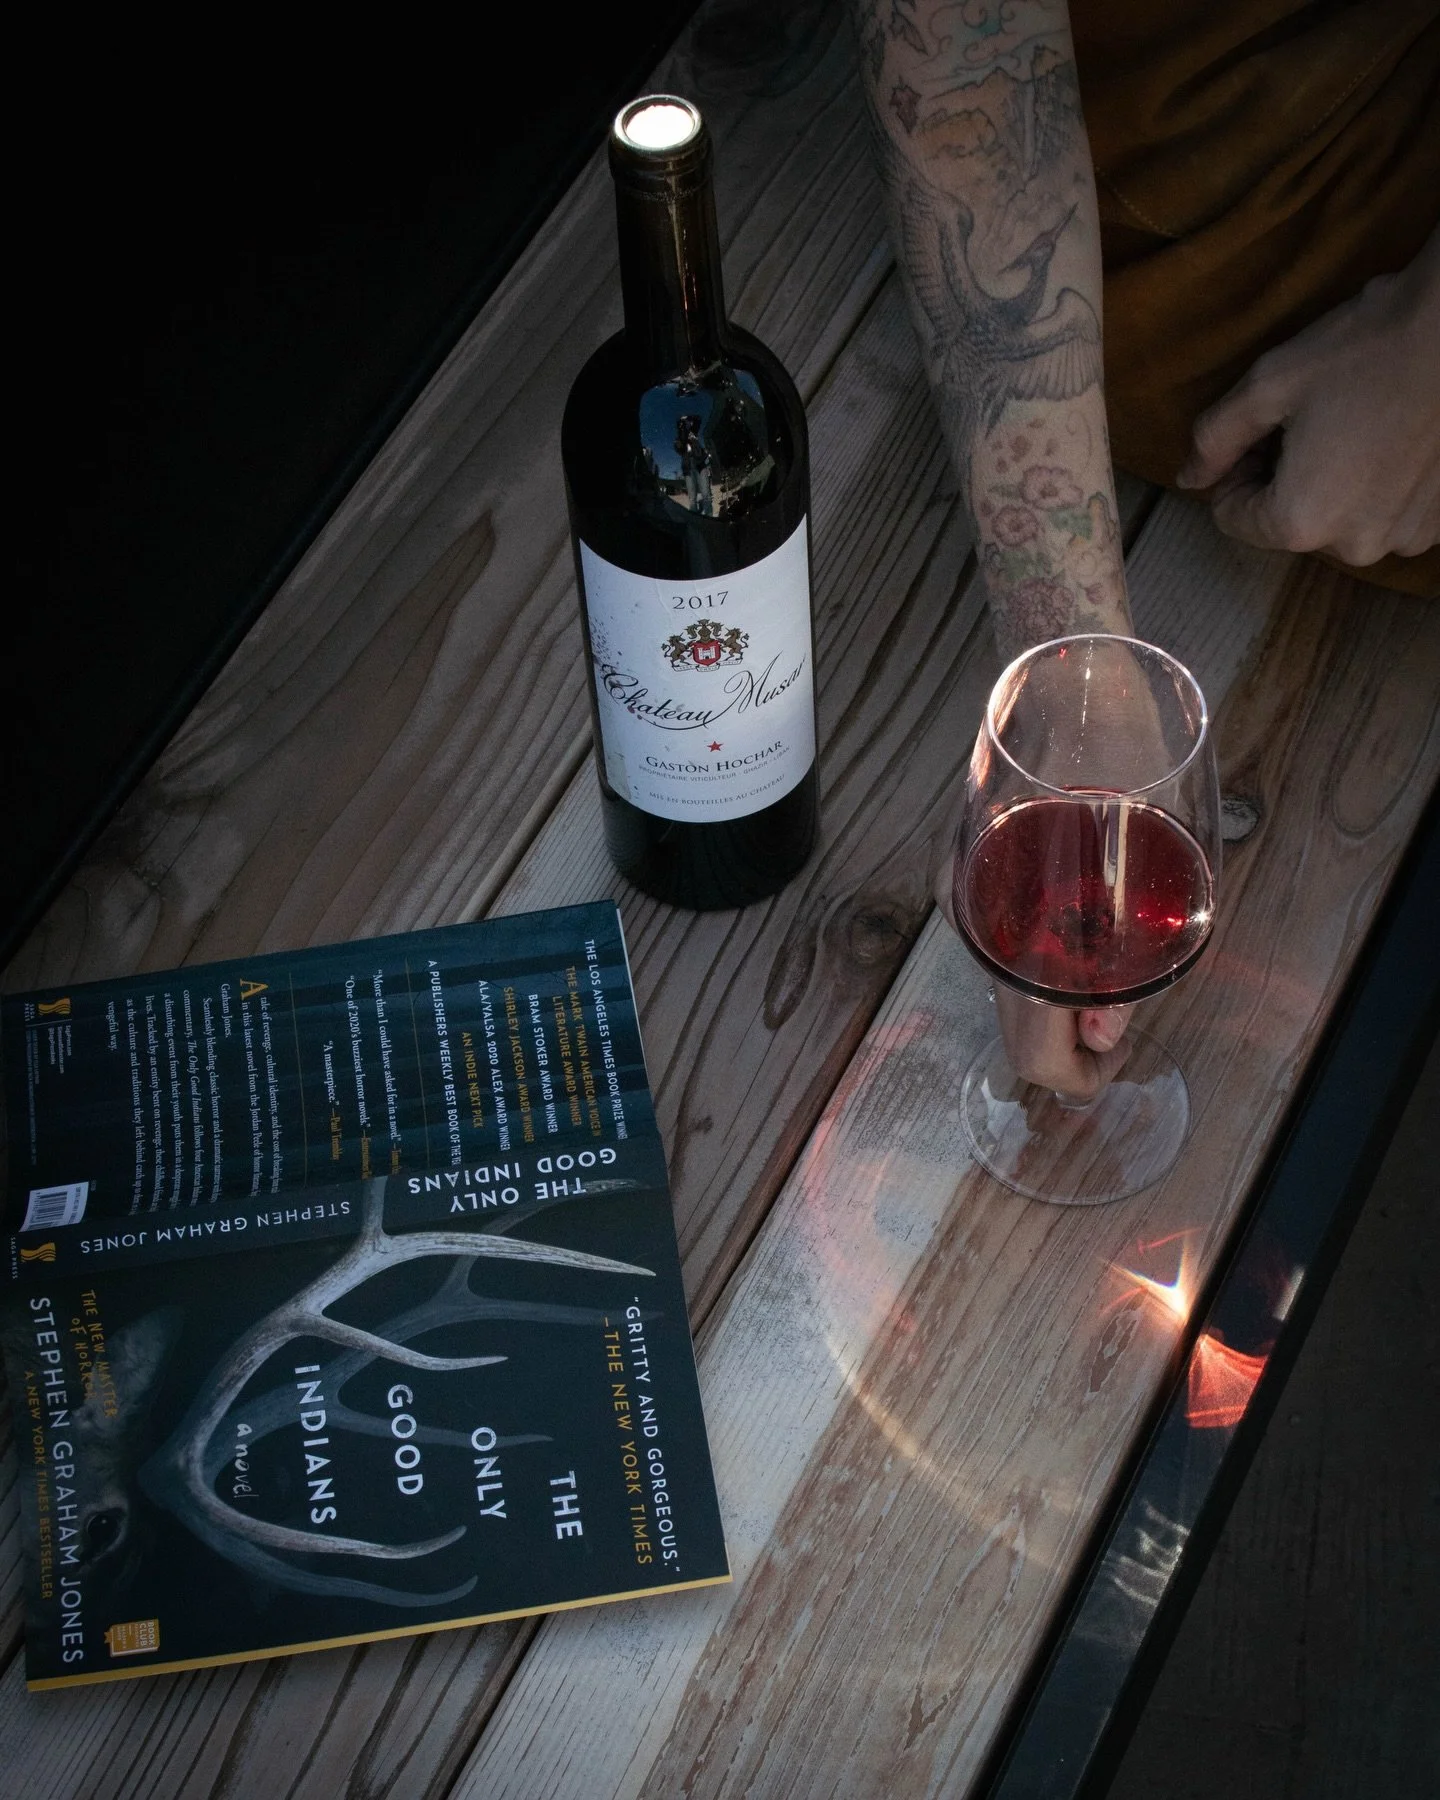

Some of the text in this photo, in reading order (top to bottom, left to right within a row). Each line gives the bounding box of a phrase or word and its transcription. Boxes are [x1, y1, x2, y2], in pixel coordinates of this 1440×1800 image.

[672, 591, 729, 610] 2017
[646, 740, 783, 774] GASTON HOCHAR
[584, 939, 596, 960] THE
[345, 975, 354, 998] “One
[372, 969, 383, 996] “More
[588, 964, 600, 985] LOS
[105, 1001, 118, 1050] vengeful way.
[220, 983, 232, 1037] Graham Jones.
[347, 1000, 358, 1009] of
[348, 1011, 360, 1038] 2020’s
[375, 998, 386, 1017] than
[429, 971, 447, 1035] PUBLISHERS
[592, 989, 609, 1036] ANGELES
[239, 978, 282, 1139] A tale cultural and the
[323, 1040, 332, 1051] “A
[351, 1039, 362, 1072] buzziest
[379, 1025, 391, 1048] could
[382, 1050, 391, 1068] have
[439, 1039, 453, 1080] WEEKLY
[502, 986, 531, 1113] SHIRLEY JACKSON AWARD
[565, 966, 600, 1129] THE MARK TWAIN AMERICAN VOICE
[601, 1039, 614, 1069] TIMES
[145, 995, 165, 1164] lives. Tracked by entity bent these
[164, 998, 184, 1156] disturbing event from their youth puts them
[202, 997, 223, 1133] Seamlessly blending classic horror and
[242, 1012, 261, 1131] this latest novel from the Jordan
[323, 1053, 339, 1105] masterpiece.”
[384, 1070, 396, 1092] asked
[461, 1032, 483, 1128] AN INDIE NEXT PICK
[478, 980, 510, 1150] ALA/YALSA 2020 ALEX AWARD WINNER
[528, 994, 557, 1133] BRAM STOKER AWARD WINNER
[552, 995, 581, 1126] LITERATURE AWARD WINNER
[127, 1008, 145, 1163] the culture and traditions they left behind
[186, 1055, 203, 1148] Only Good follows
[355, 1073, 365, 1099] horror
[386, 1093, 397, 1105] for
[444, 1084, 456, 1105] BEST
[606, 1071, 620, 1097] BOOK
[447, 1108, 459, 1132] BOOK
[611, 1098, 623, 1120] PRIZE
[449, 1133, 460, 1143] OF
[451, 1144, 461, 1156] THE
[407, 1148, 616, 1193] GOOD INDIANS
[450, 1177, 586, 1212] THE ONLY
[80, 1201, 349, 1253] STEPHEN GRAHAM JONES
[70, 1318, 97, 1401] OF HORROR
[81, 1290, 118, 1417] THE NEW MASTER
[611, 1384, 632, 1430] NEW
[638, 1395, 657, 1437] AND
[232, 1424, 259, 1498] a novel
[294, 1365, 336, 1523] INDIANS
[387, 1384, 422, 1494] GOOD
[24, 1371, 53, 1599] A NEW YORK TIMES BESTSELLER
[30, 1297, 83, 1662] STEPHEN GRAHAM JONES
[471, 1427, 506, 1518] ONLY
[620, 1441, 641, 1494] YORK
[549, 1470, 582, 1539] THE
[630, 1504, 652, 1563] TIMES
[139, 1622, 147, 1648] CLUB
[148, 1620, 156, 1648] BOOK
